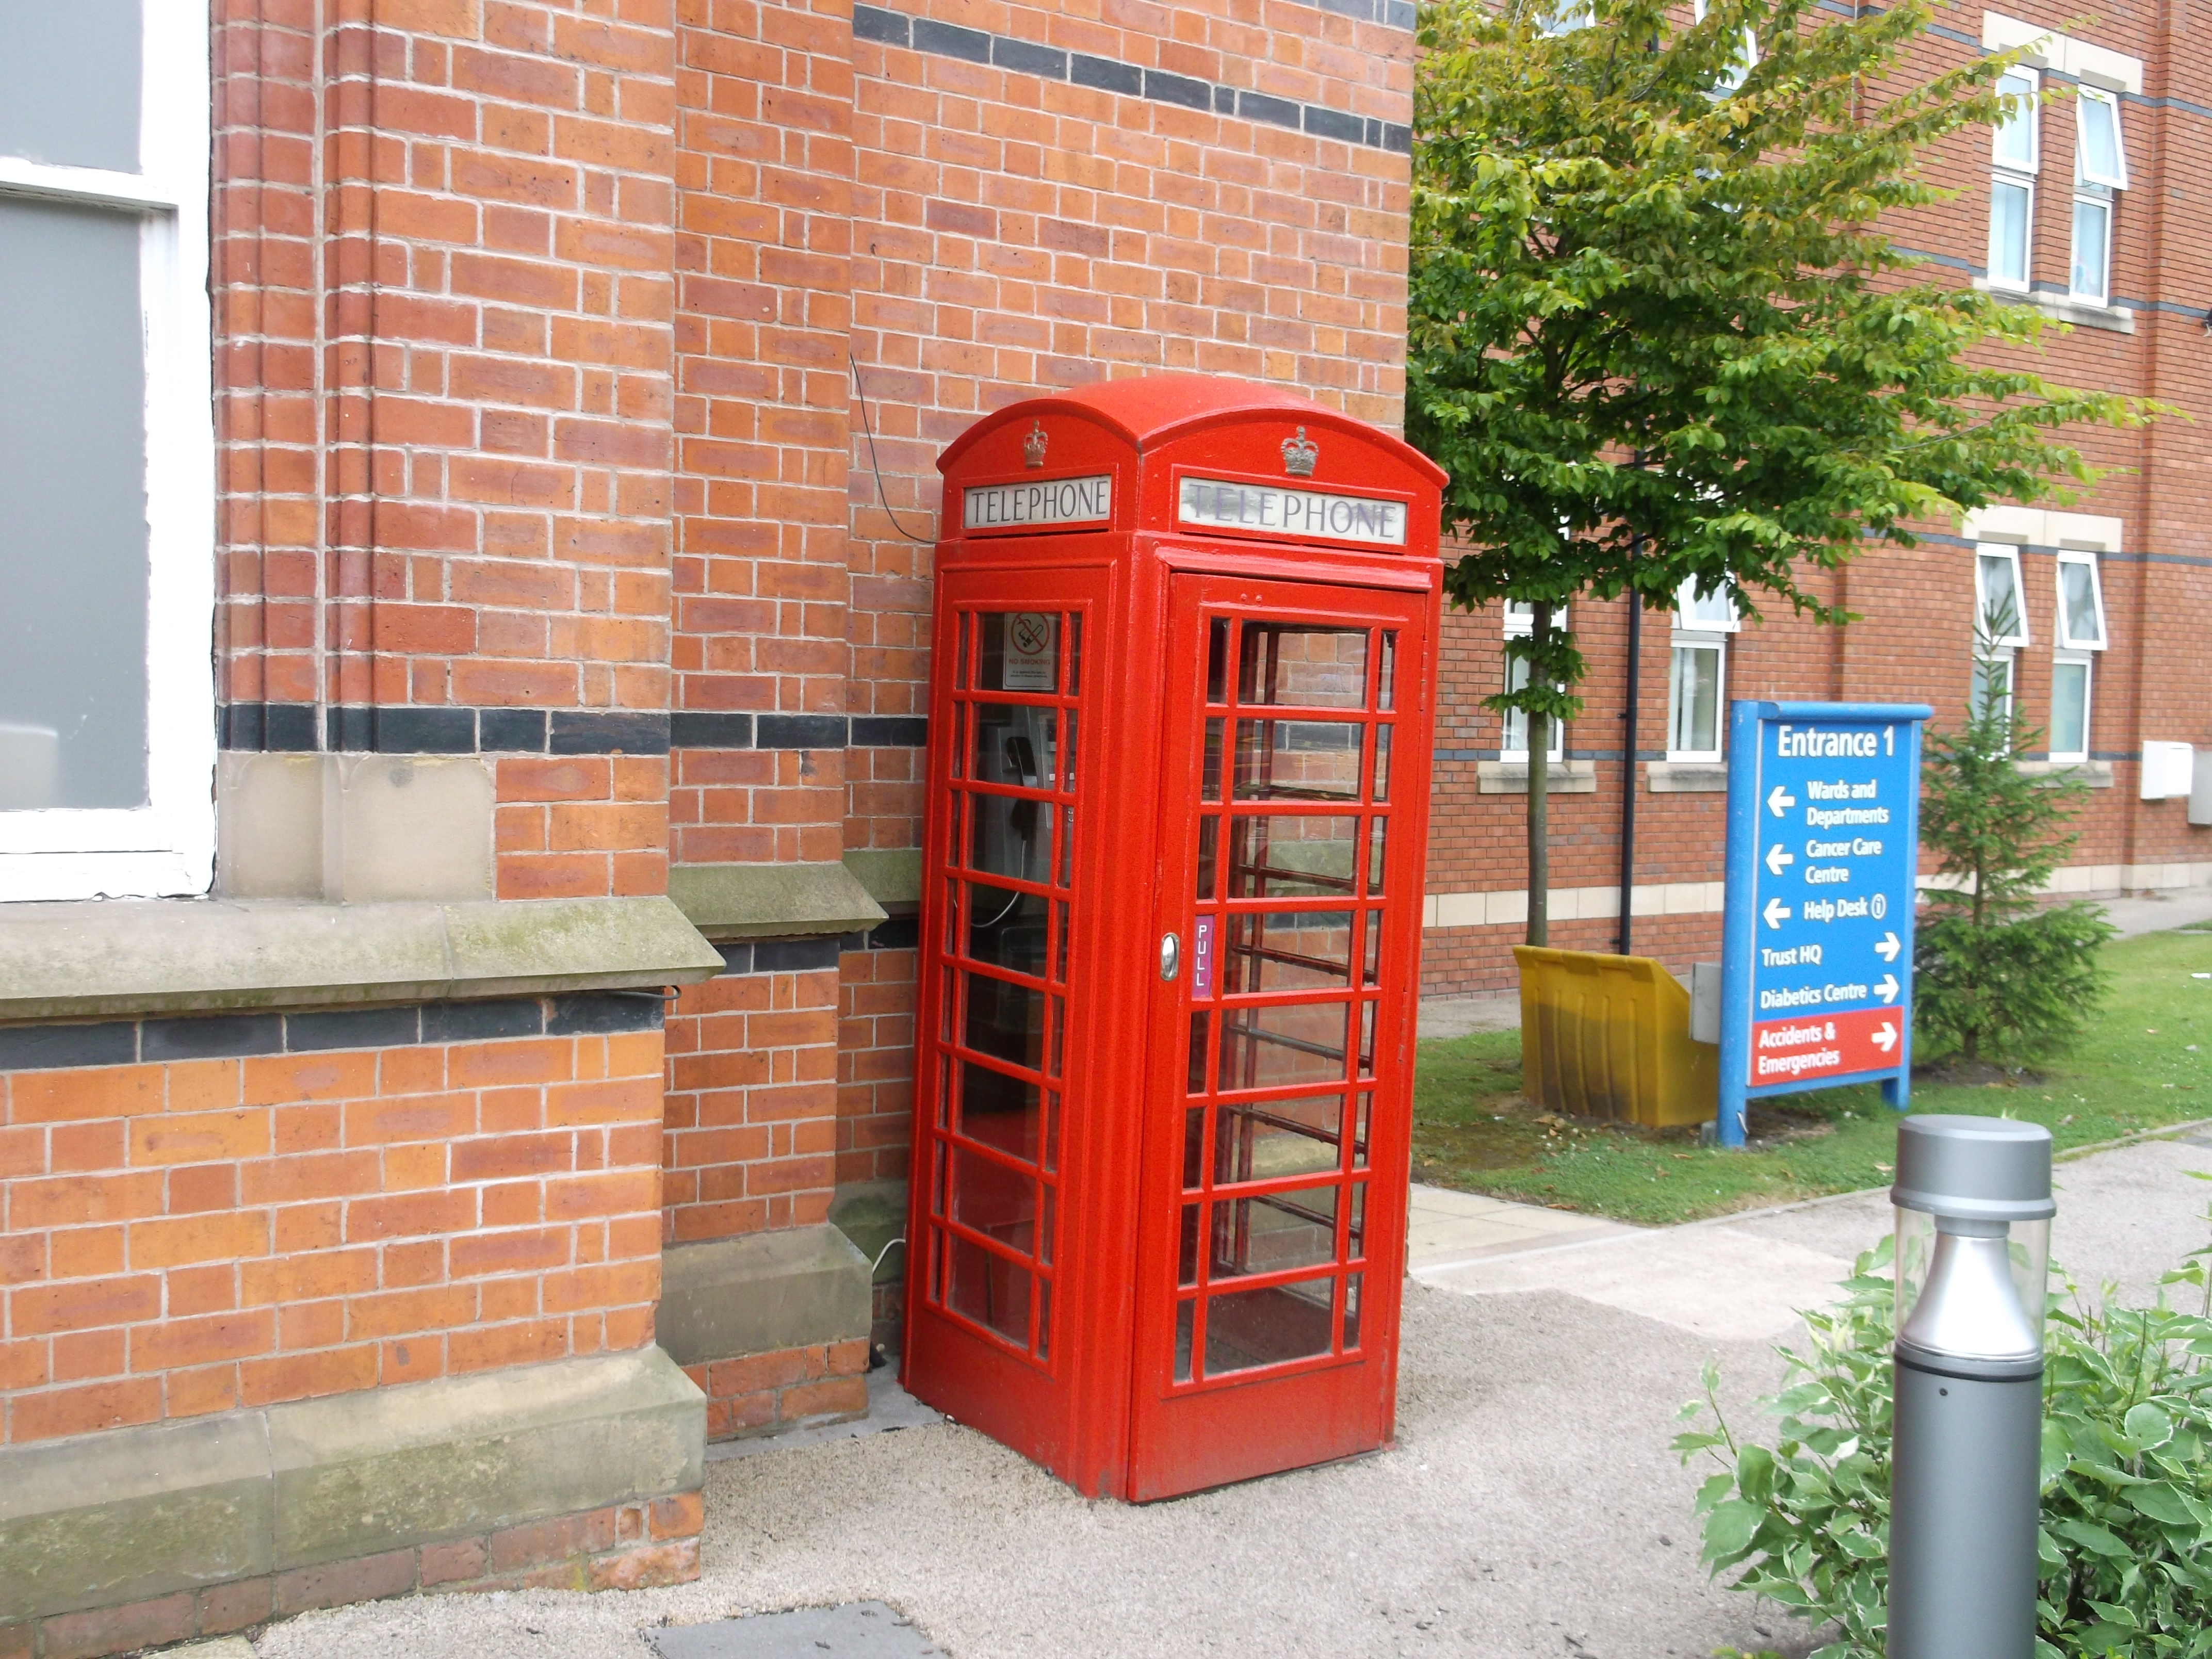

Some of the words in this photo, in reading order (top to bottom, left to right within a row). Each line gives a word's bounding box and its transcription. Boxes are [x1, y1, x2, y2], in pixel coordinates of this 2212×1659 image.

[972, 480, 1108, 523] TELEPHONE
[1189, 483, 1396, 538] TELEPHONE
[1779, 725, 1877, 756] Entrance
[1883, 725, 1894, 756] 1
[1808, 779, 1849, 799] Wards
[1851, 779, 1876, 798] and
[1807, 807, 1889, 829] Departments
[1806, 840, 1850, 857] Cancer
[1852, 838, 1882, 855] Care
[1806, 866, 1848, 883] Centre
[1804, 899, 1834, 922] Help
[1837, 897, 1867, 917] Desk
[1197, 925, 1207, 986] PULL
[1762, 948, 1797, 966] Trust
[1800, 945, 1821, 965] HQ
[1761, 986, 1821, 1008] Diabetics
[1824, 983, 1867, 1001] Centre
[1759, 1026, 1822, 1048] Accidents
[1824, 1022, 1836, 1040] &
[1759, 1047, 1840, 1075] Emergencies
